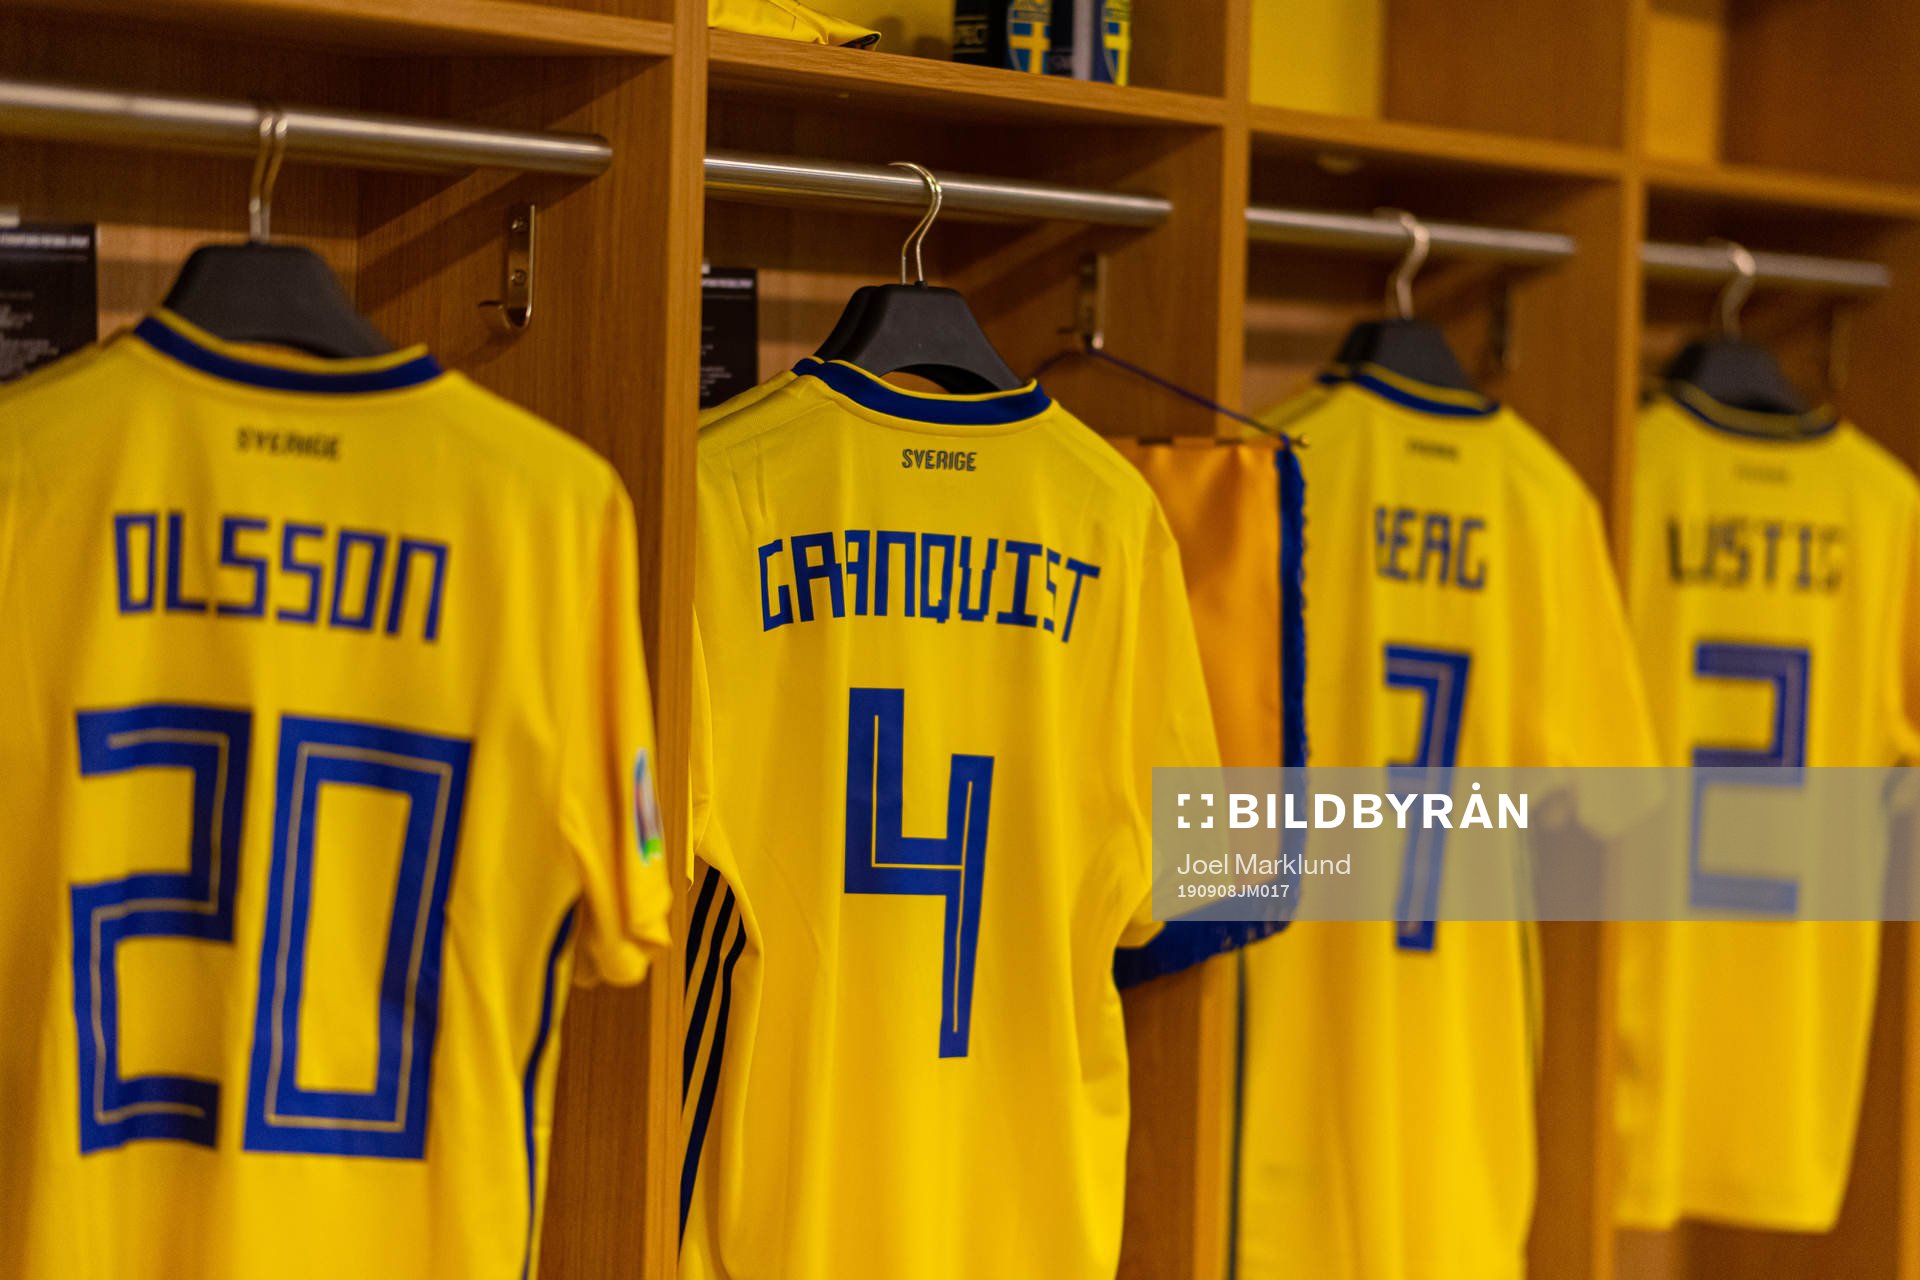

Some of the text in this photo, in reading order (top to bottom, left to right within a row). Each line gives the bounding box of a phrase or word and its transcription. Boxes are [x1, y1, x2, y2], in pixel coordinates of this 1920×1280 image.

[113, 511, 450, 643] OLSSON
[901, 448, 978, 472] SVERIGE
[844, 687, 995, 1058] 4
[1688, 640, 1811, 917] 2
[68, 703, 475, 1162] 20
